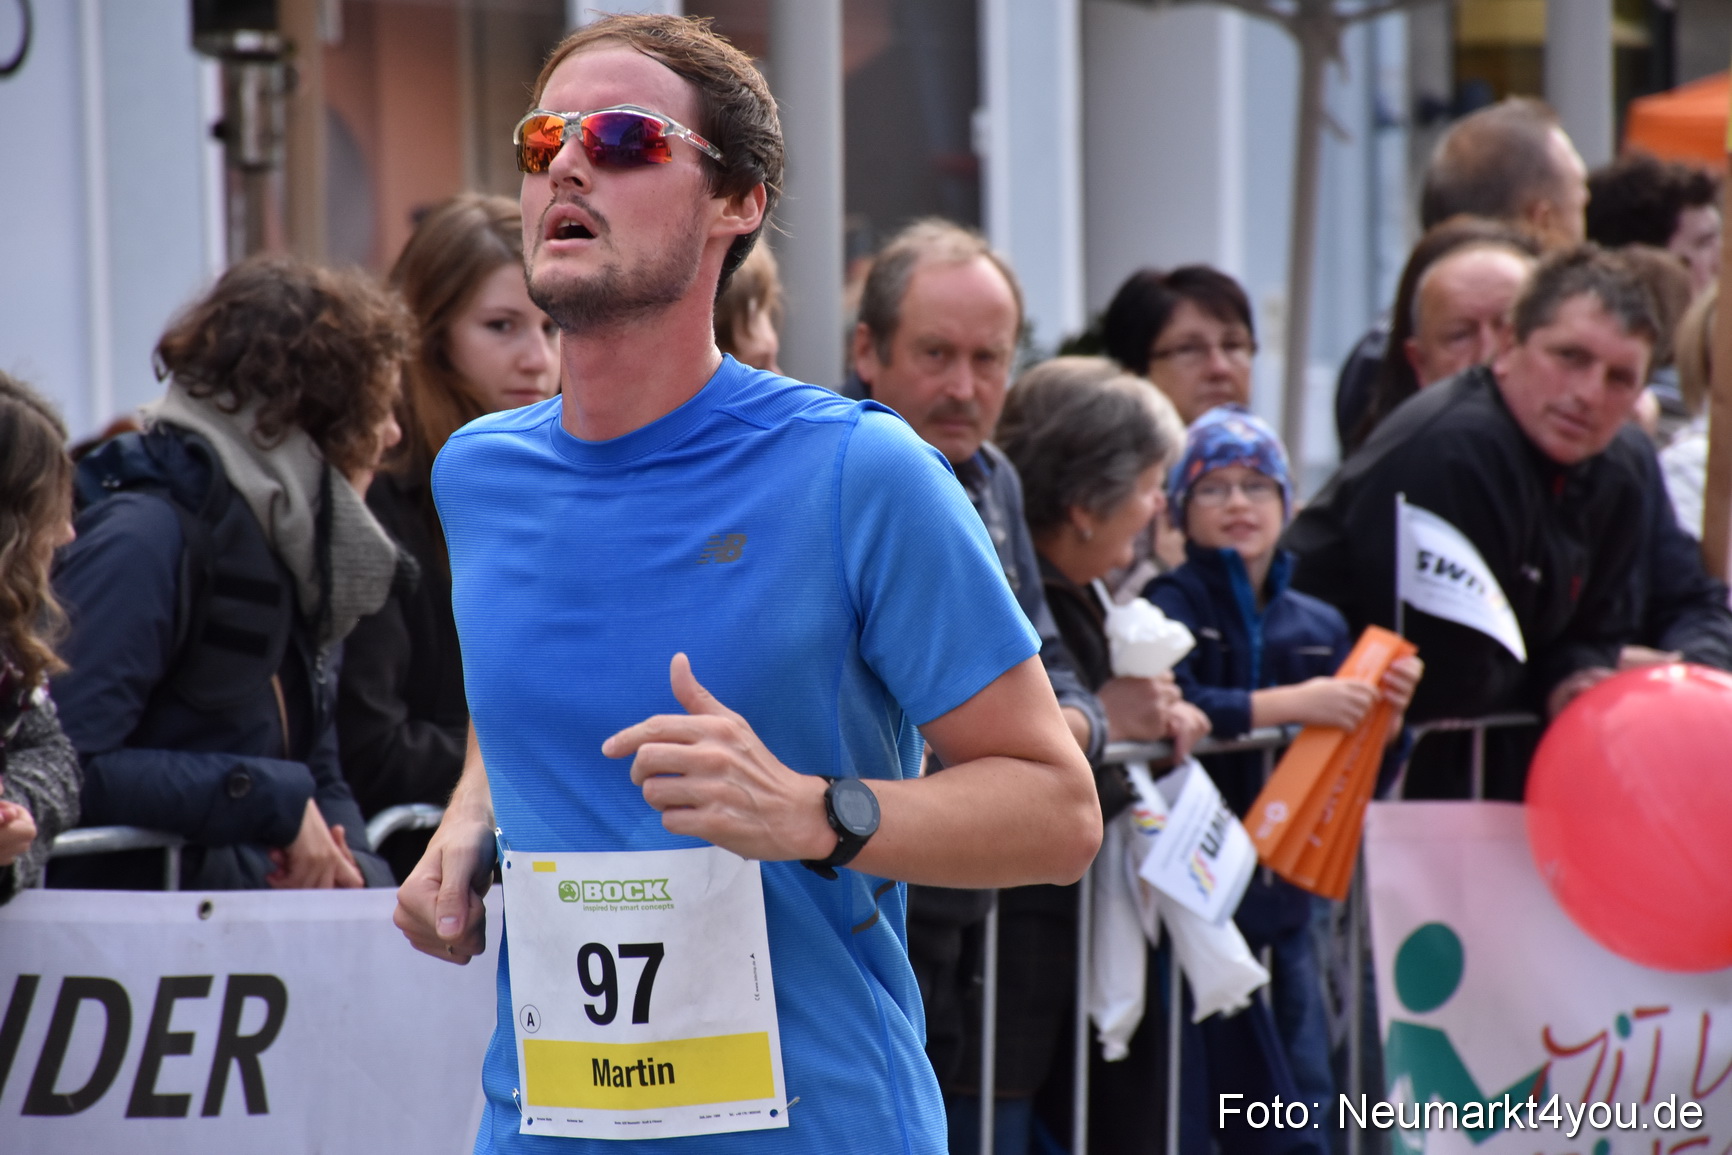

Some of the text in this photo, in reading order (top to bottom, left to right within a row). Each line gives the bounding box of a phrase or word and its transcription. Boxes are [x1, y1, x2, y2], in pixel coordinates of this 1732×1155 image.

[581, 878, 673, 903] BOCK
[583, 904, 609, 913] inspired
[609, 904, 619, 912] by
[641, 903, 675, 911] concepts
[576, 942, 665, 1026] 97
[526, 1012, 536, 1028] A
[591, 1057, 676, 1089] Martin
